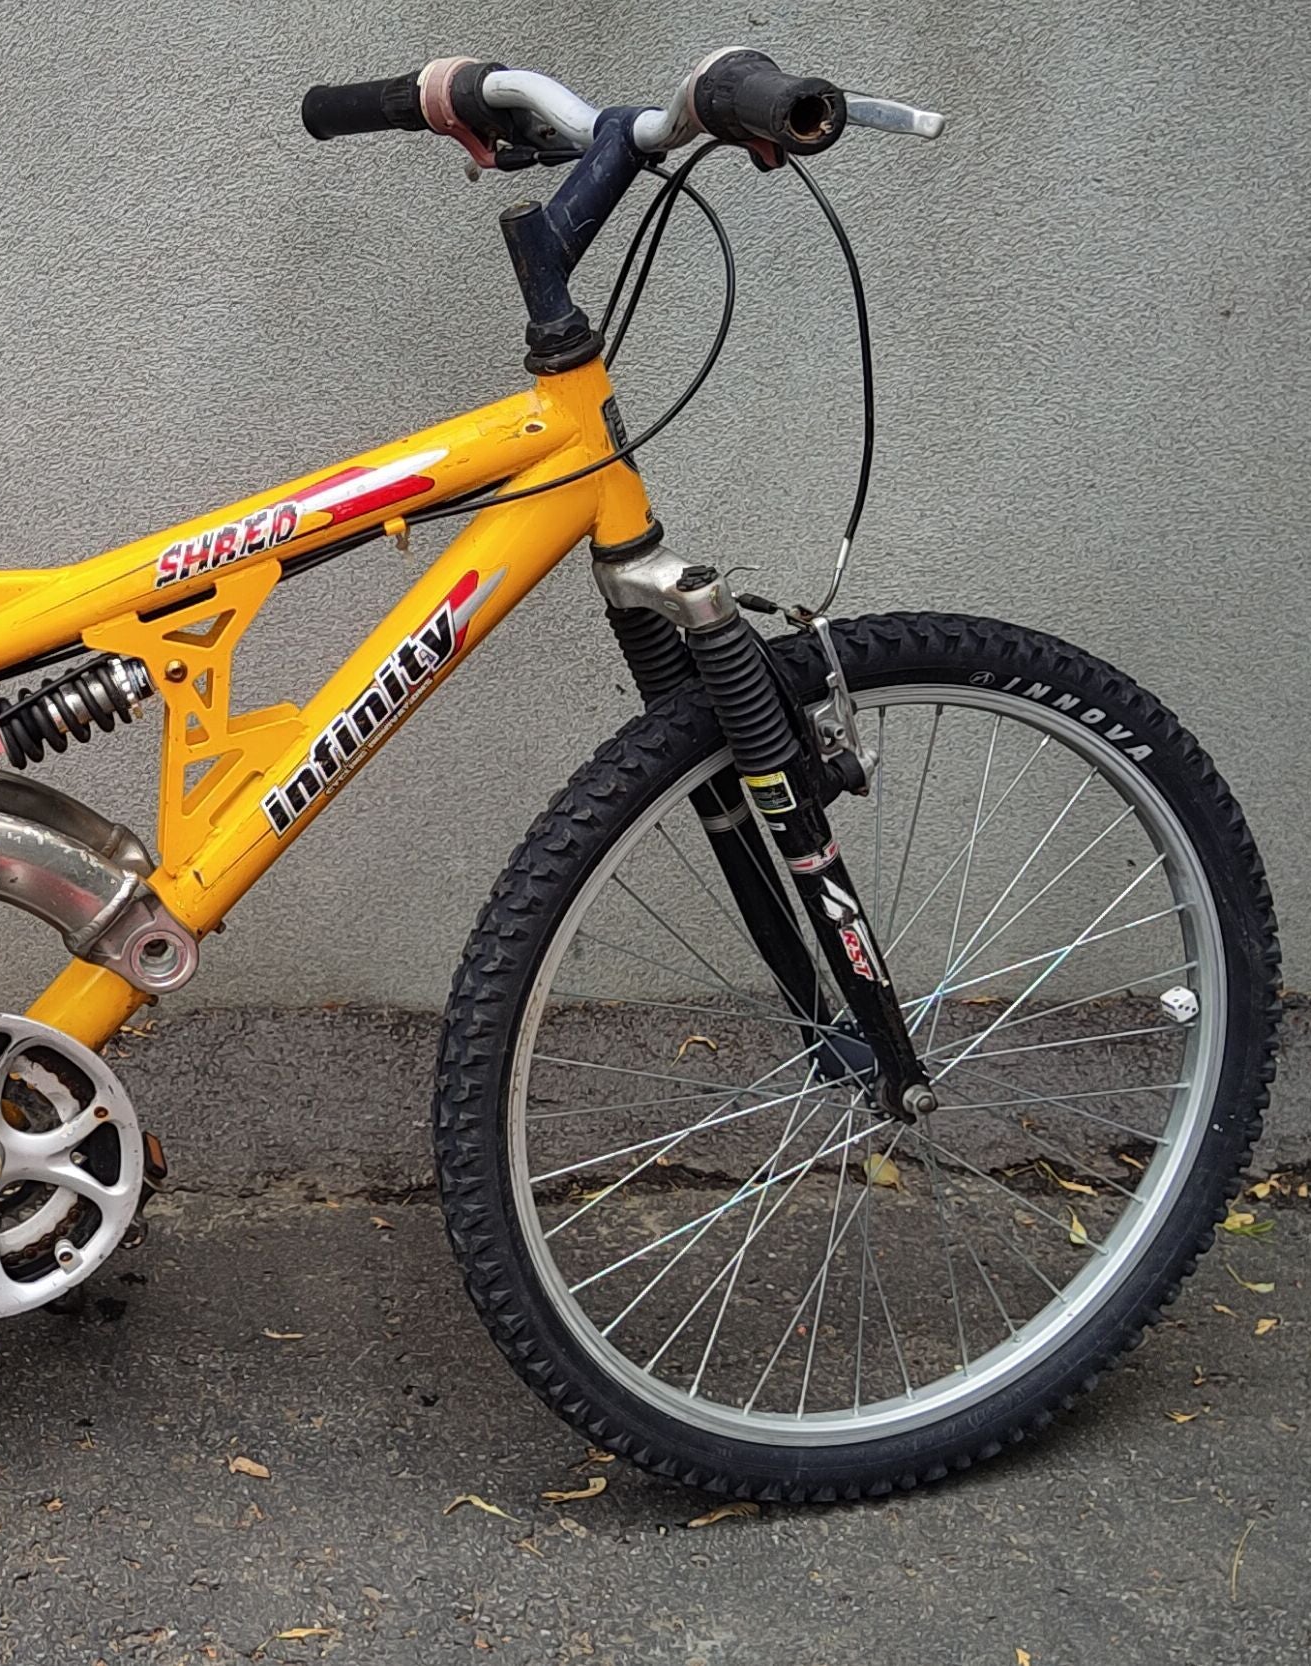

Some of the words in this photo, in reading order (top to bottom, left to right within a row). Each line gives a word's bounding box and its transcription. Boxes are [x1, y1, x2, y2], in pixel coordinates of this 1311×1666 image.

[155, 502, 301, 589] SHRED
[259, 600, 456, 838] infinity
[1002, 676, 1154, 762] INNOVA
[840, 926, 875, 982] RST
